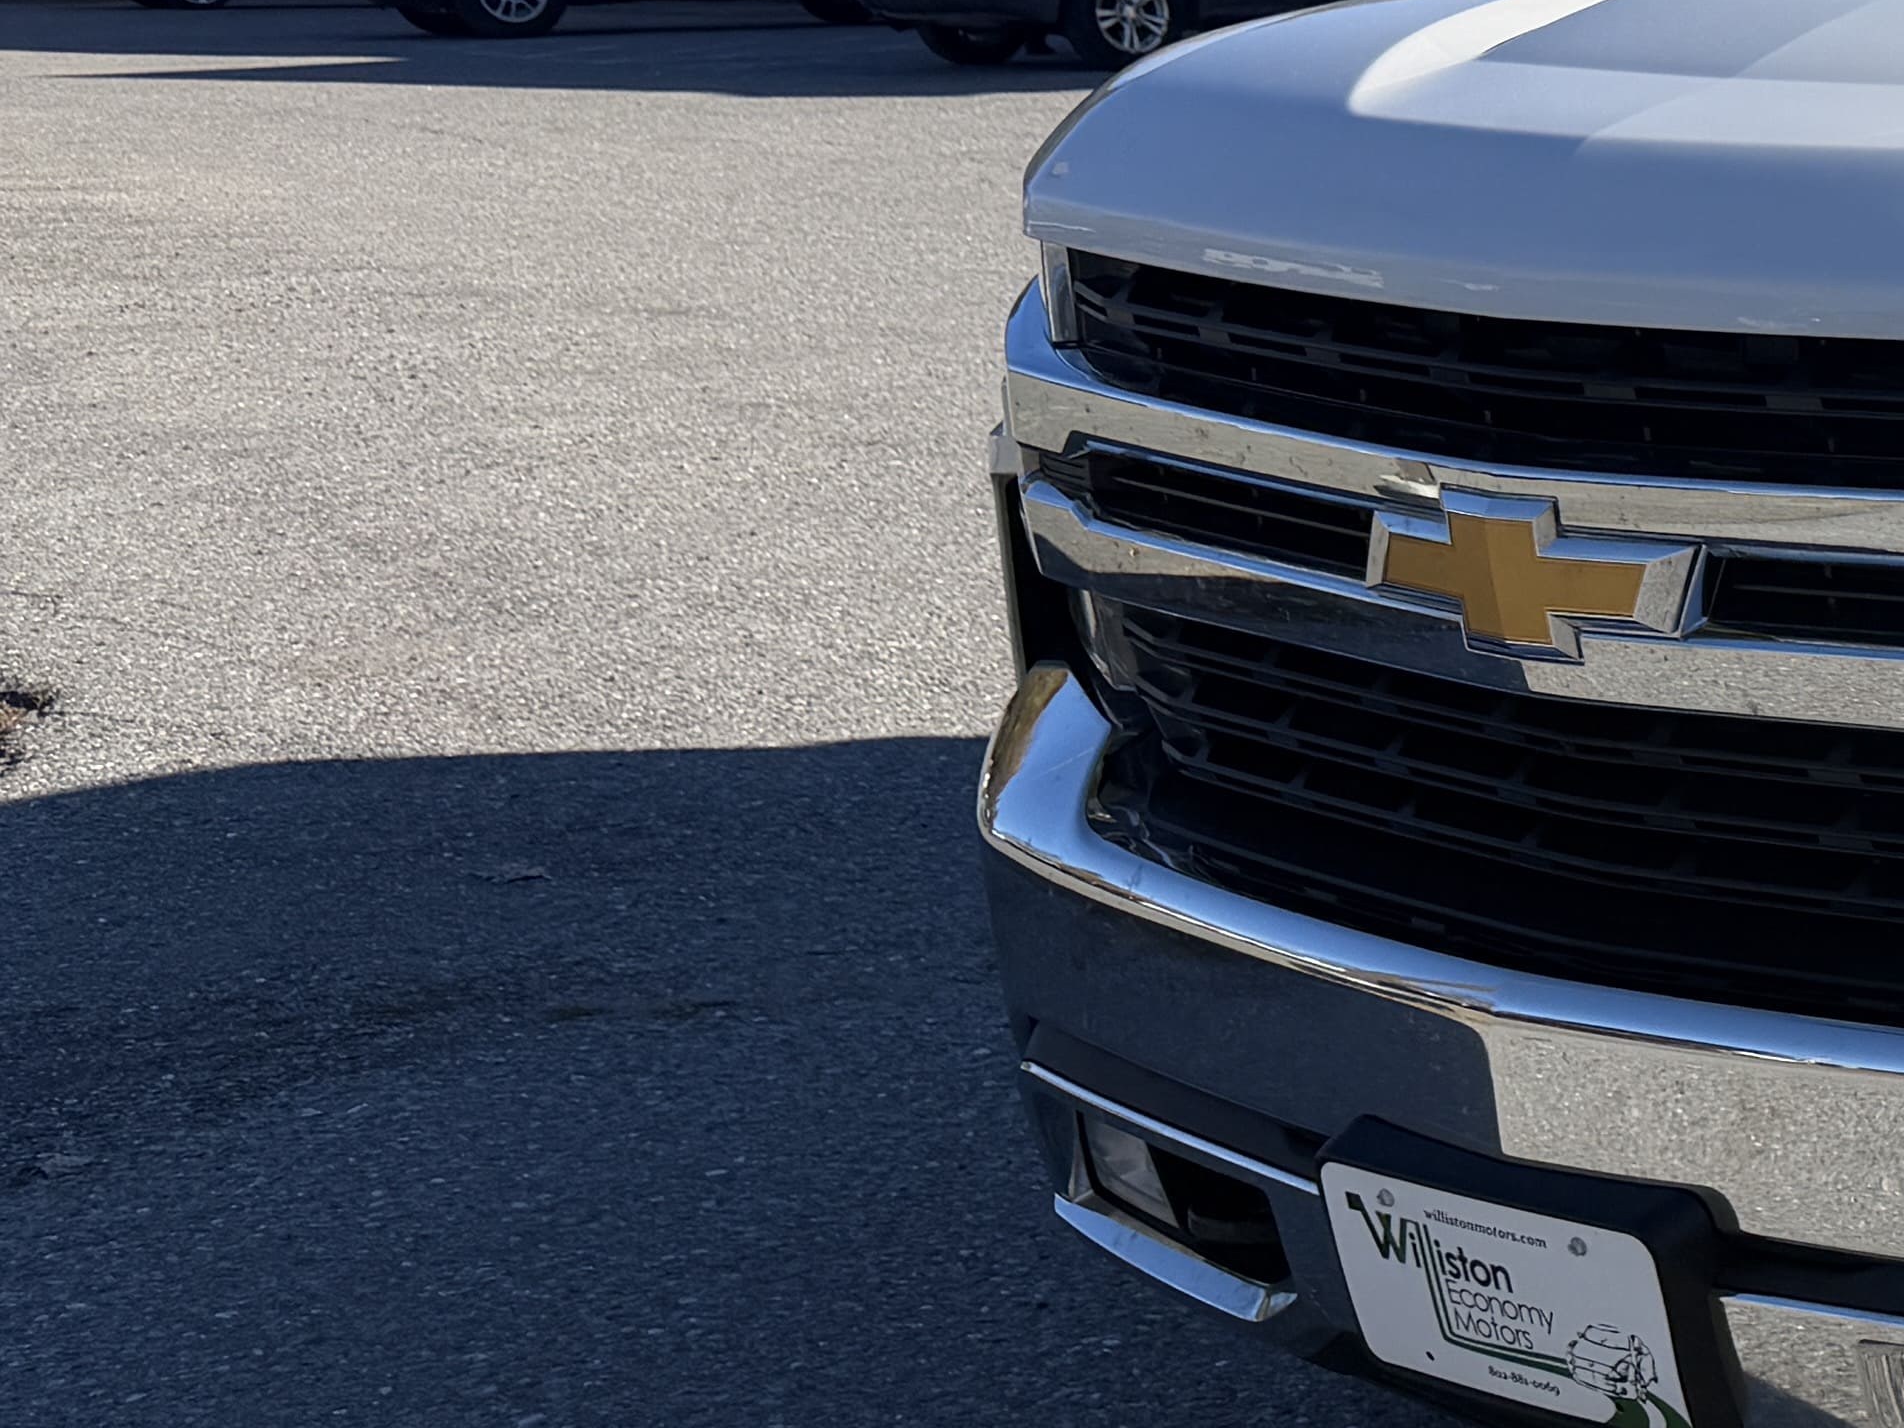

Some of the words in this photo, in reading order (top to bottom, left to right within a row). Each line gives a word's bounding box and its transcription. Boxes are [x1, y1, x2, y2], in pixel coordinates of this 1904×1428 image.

[1345, 1191, 1514, 1294] Williston
[1423, 1209, 1548, 1249] willistonmotors.com
[1446, 1278, 1554, 1335] Economy
[1454, 1308, 1534, 1350] Motors
